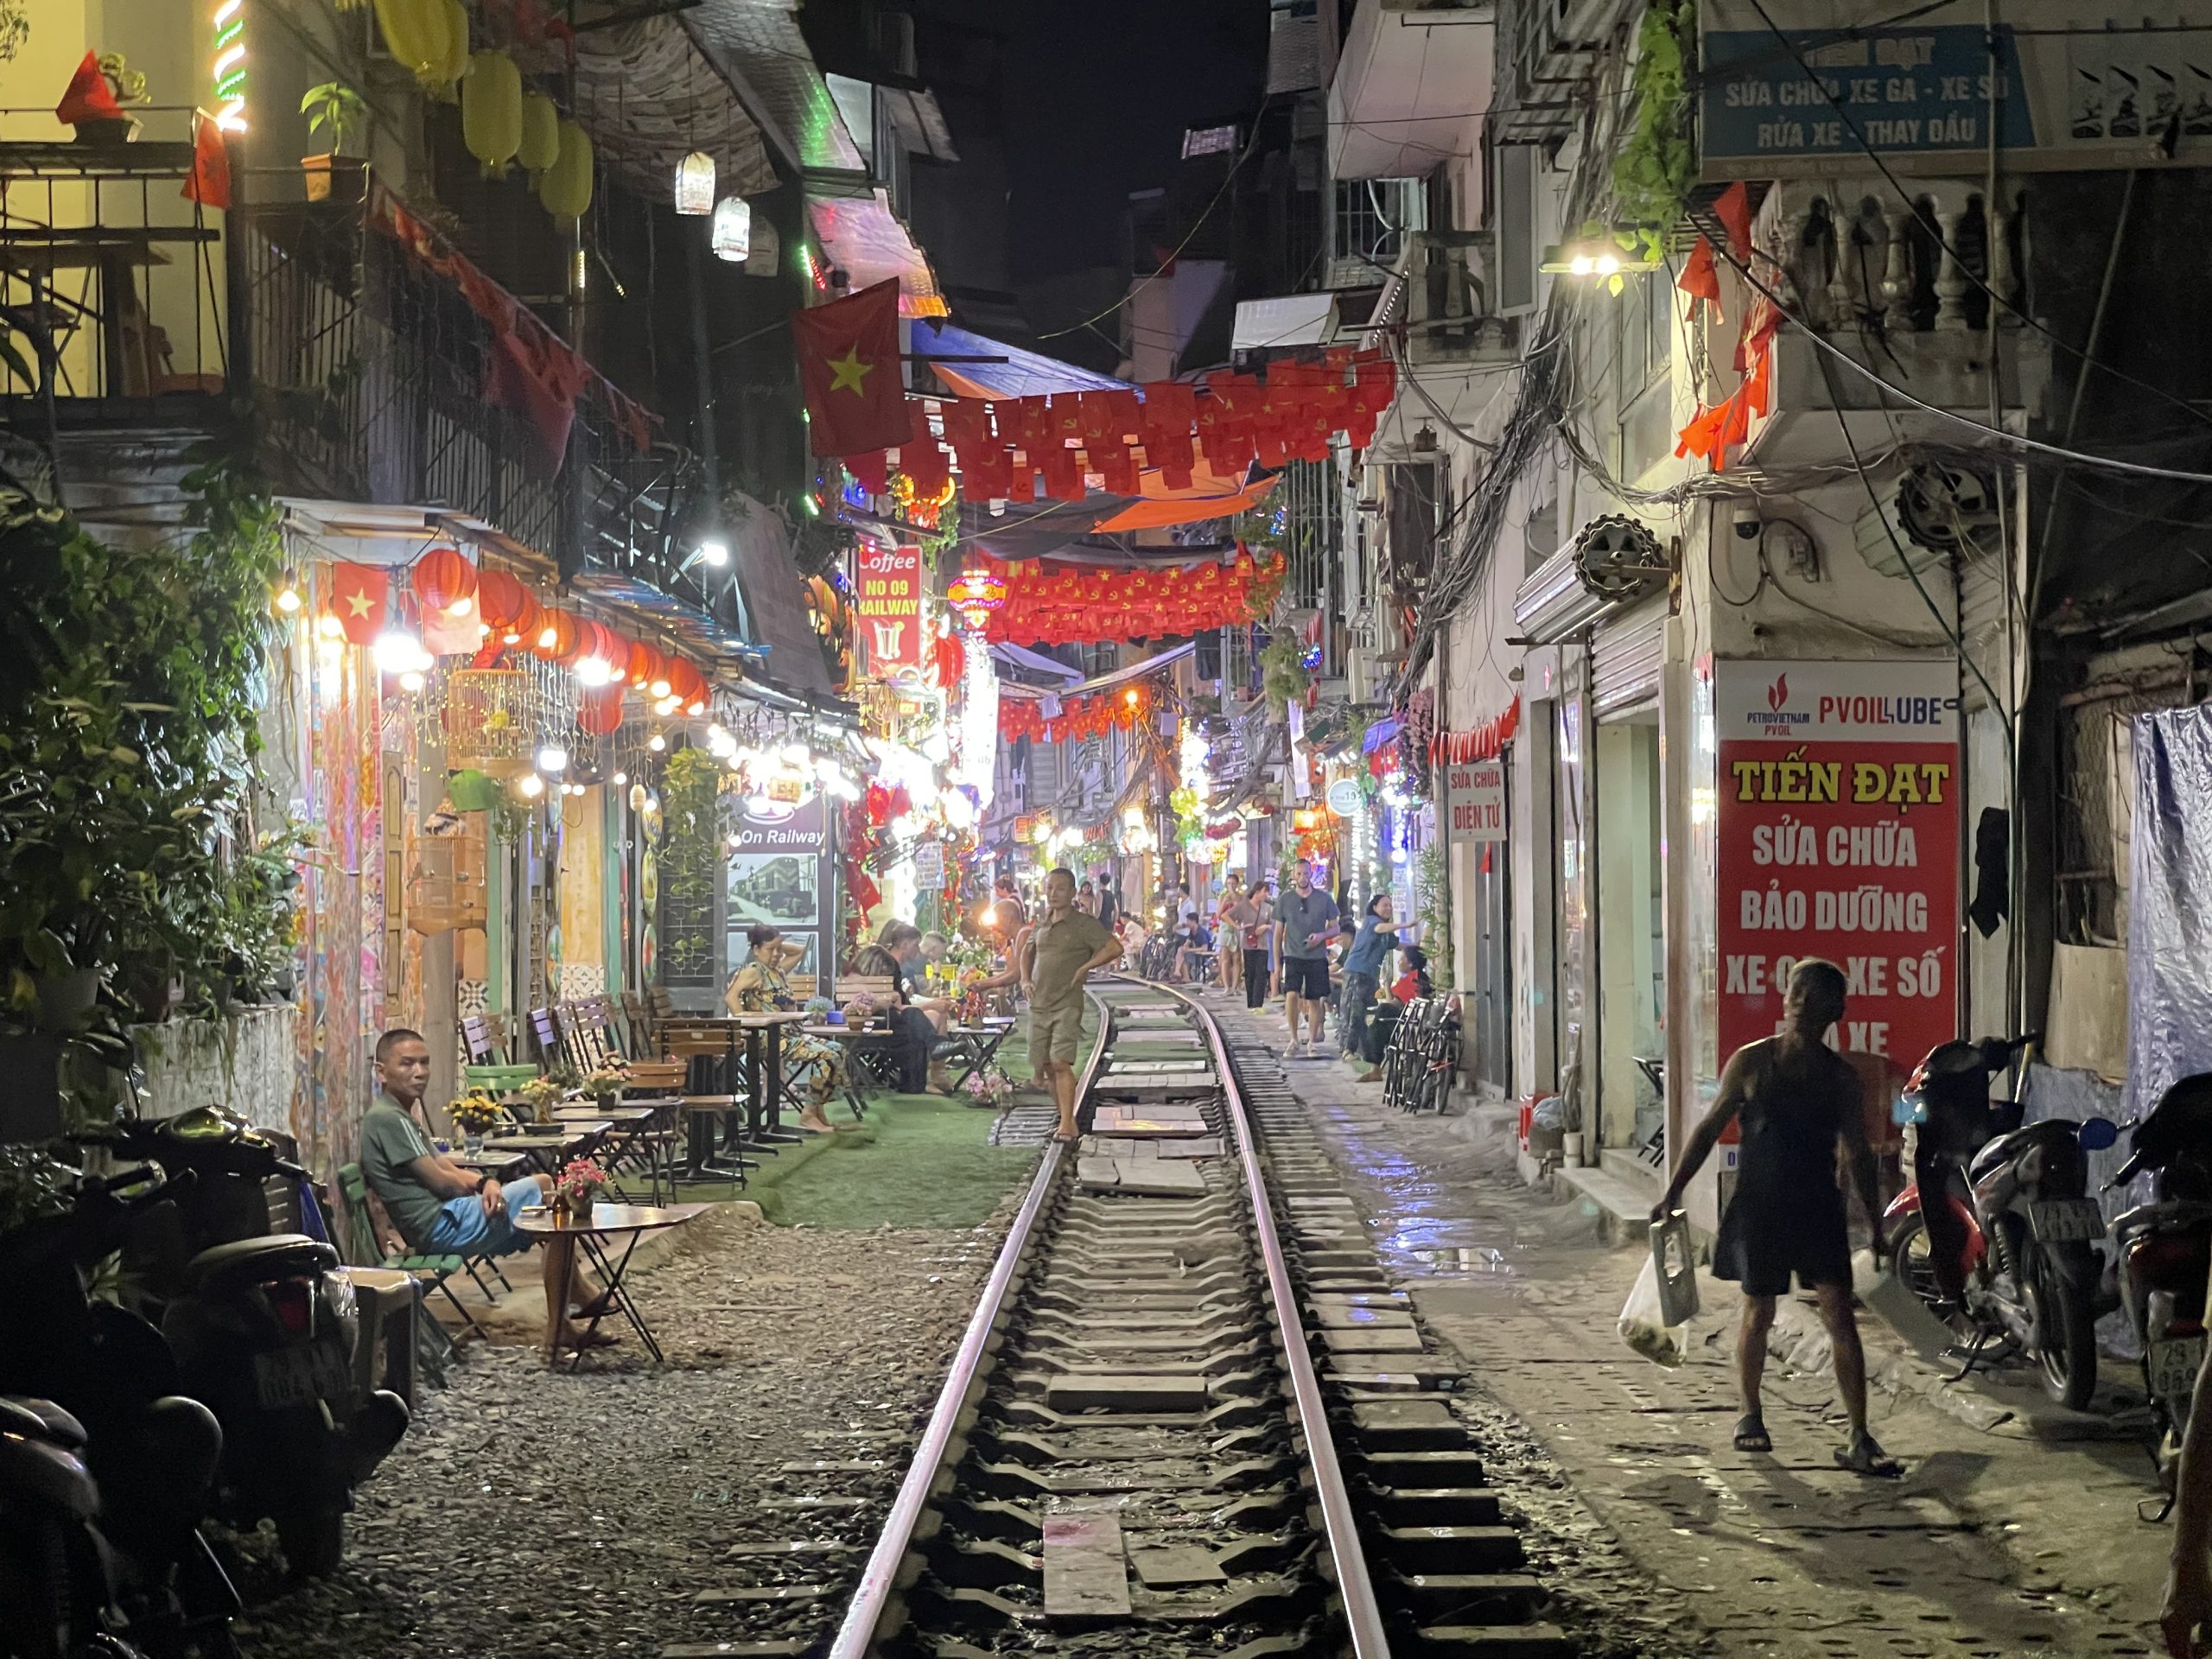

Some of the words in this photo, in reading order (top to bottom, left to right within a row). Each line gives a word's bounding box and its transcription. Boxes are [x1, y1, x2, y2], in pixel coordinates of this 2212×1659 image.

[1850, 79, 1878, 103] XE
[1886, 78, 1916, 102] GA
[1940, 76, 1970, 100] XE
[1813, 120, 1841, 147] XE
[1866, 118, 1921, 145] THAY
[866, 580, 887, 596] NO
[890, 580, 908, 596] 09
[1747, 712, 1809, 724] PETROVIETNAM
[1764, 725, 1792, 735] PVOIL
[1732, 744, 1842, 803] TIẾN
[1853, 762, 1949, 813] ĐẠT
[742, 830, 762, 844] On
[766, 830, 824, 846] Railway
[1752, 814, 1819, 867] SỬA
[1826, 820, 1918, 868] CHỮA
[1740, 879, 1807, 931] BẢO
[1815, 885, 1928, 932] DƯỠNG
[1726, 955, 1766, 995] XE
[1847, 957, 1888, 995] XE
[1897, 945, 1947, 998] SỐ
[1847, 1021, 1890, 1058] XE
